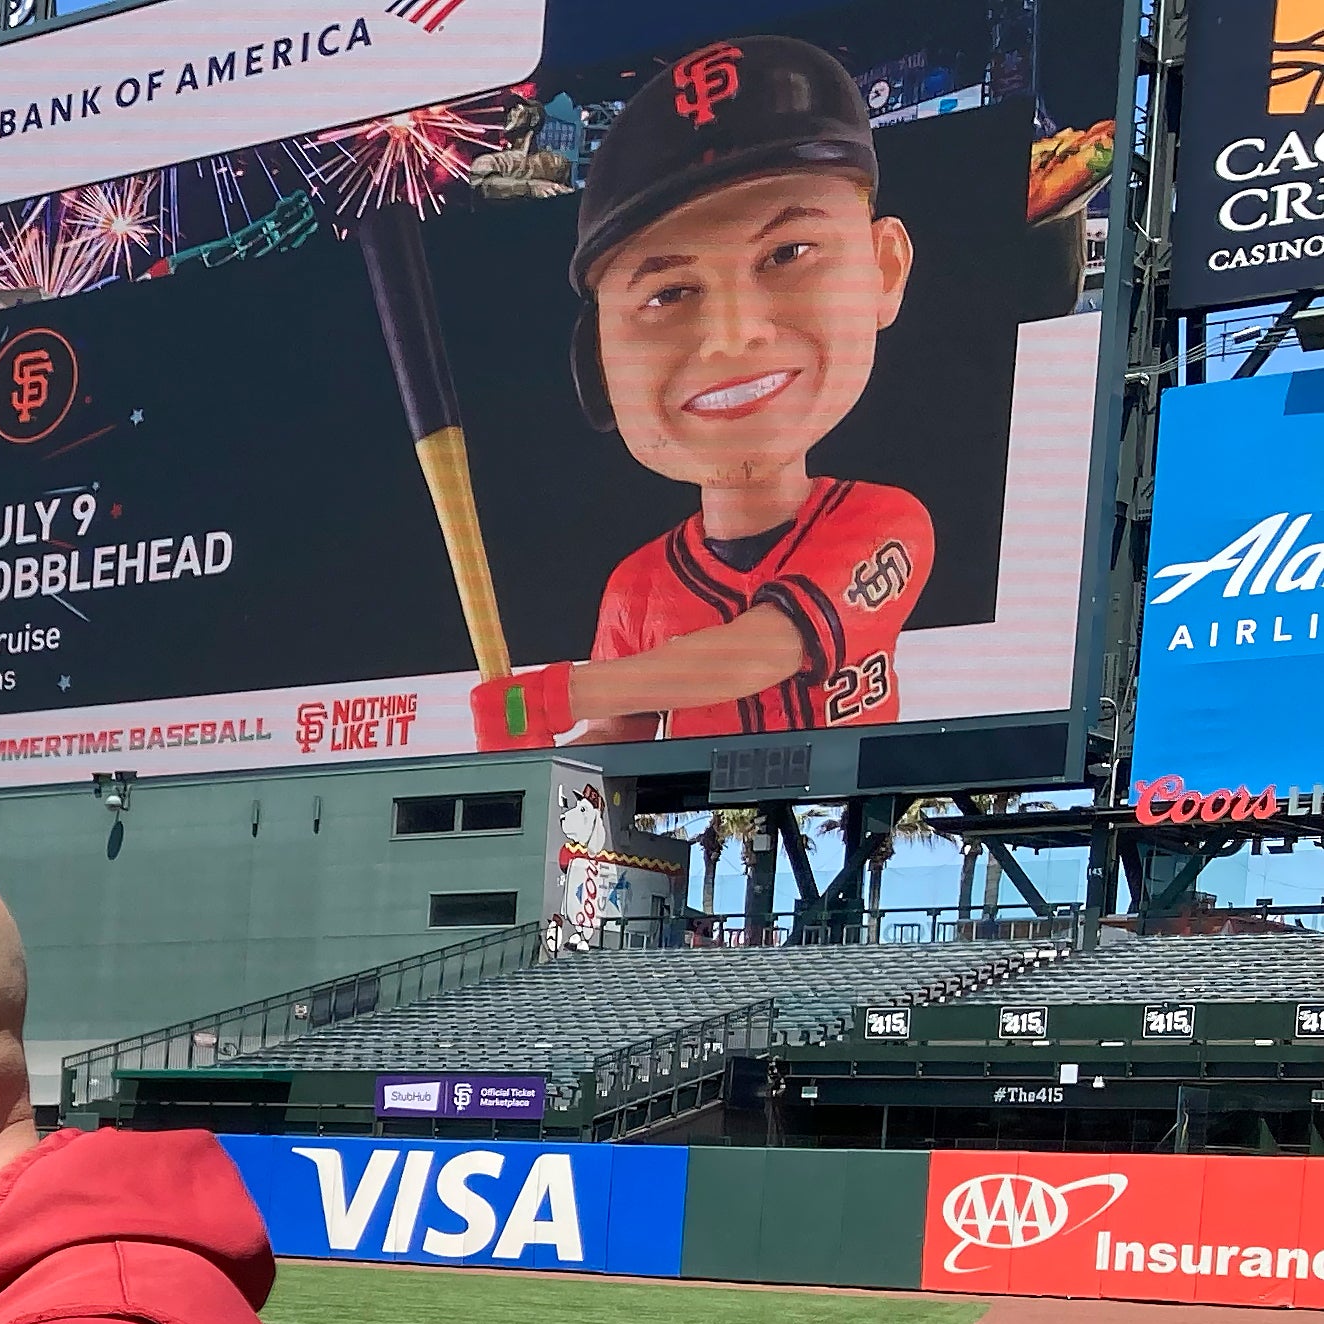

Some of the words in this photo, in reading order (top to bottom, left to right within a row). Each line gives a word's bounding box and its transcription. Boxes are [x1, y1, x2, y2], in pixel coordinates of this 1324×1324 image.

[0, 84, 102, 139] BANK
[115, 69, 166, 109] OF
[176, 16, 372, 95] AMERICA
[1215, 130, 1324, 182] CA
[1218, 178, 1324, 232] CR
[72, 493, 97, 536] 9
[1150, 512, 1324, 604] Ala
[332, 693, 417, 725] NOTHING
[824, 651, 891, 726] 23
[129, 717, 271, 751] BASEBALL
[331, 721, 379, 752] LIKE
[386, 714, 416, 746] IT
[1135, 774, 1281, 826] Coors
[391, 1091, 431, 1102] StubHub
[480, 1088, 509, 1098] Official
[510, 1088, 536, 1098] Ticket
[480, 1098, 530, 1108] Marketplace
[993, 1087, 1064, 1103] #The415
[292, 1146, 583, 1261] VISA
[956, 1177, 1053, 1247] AAA
